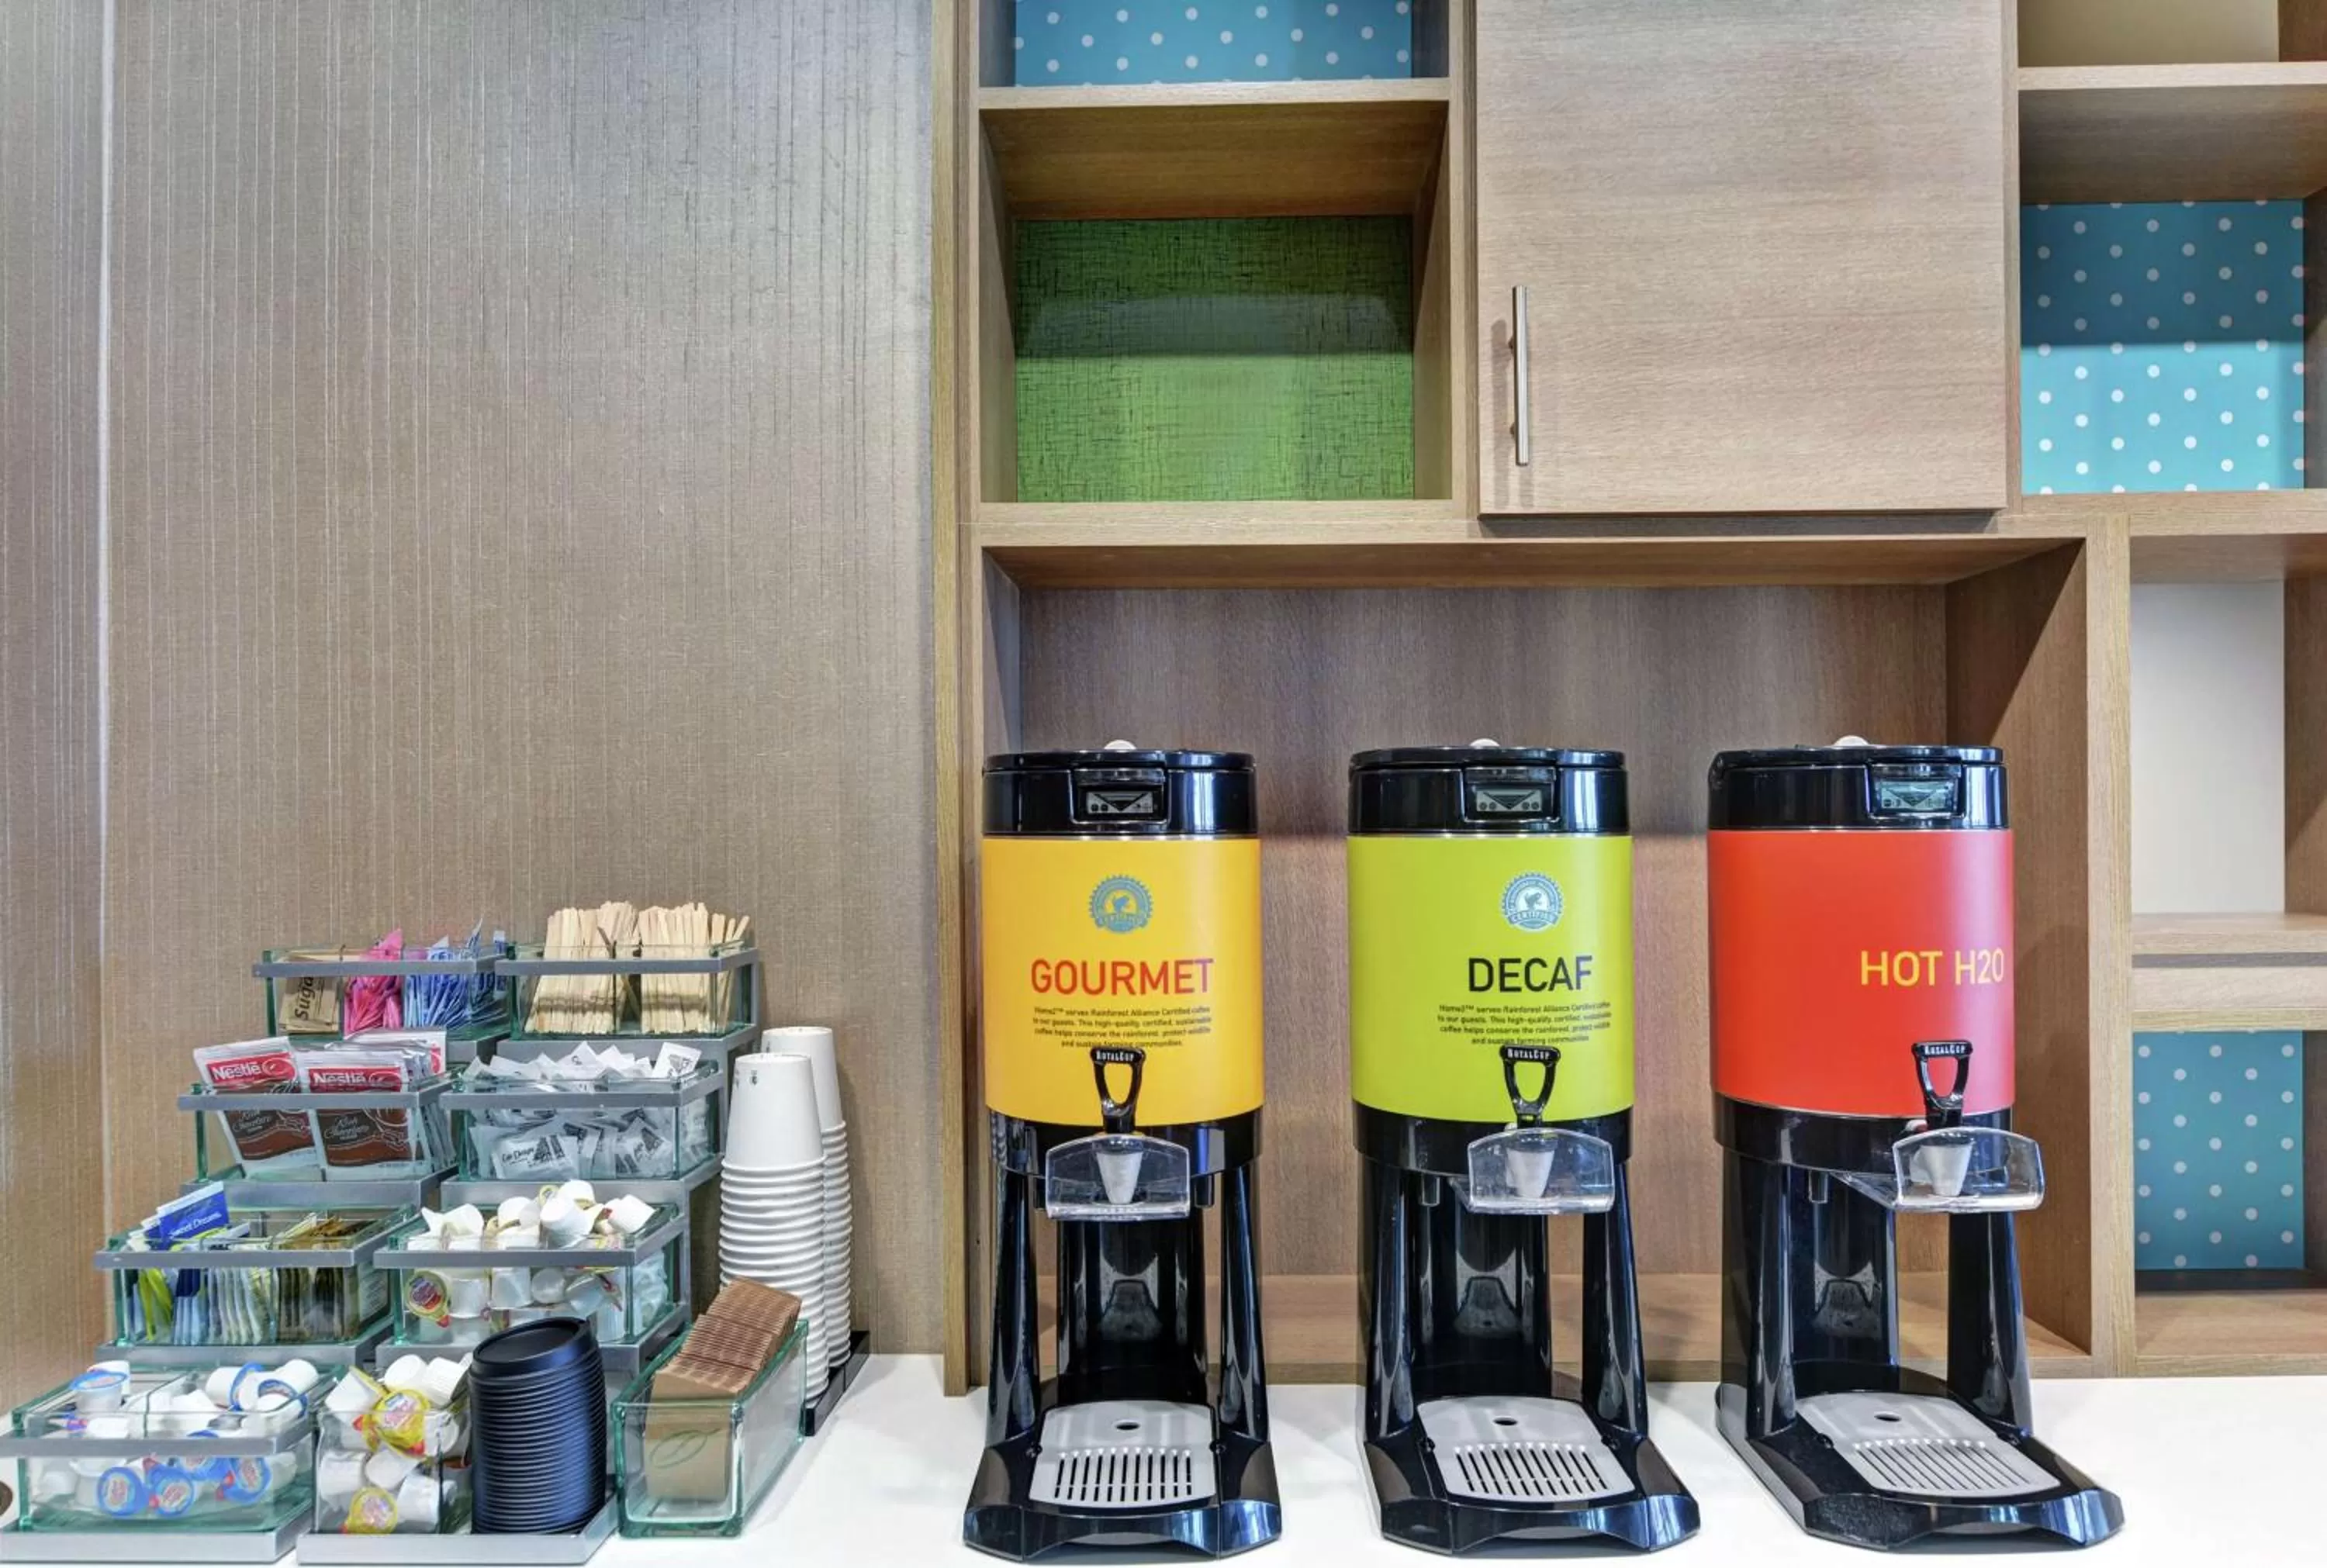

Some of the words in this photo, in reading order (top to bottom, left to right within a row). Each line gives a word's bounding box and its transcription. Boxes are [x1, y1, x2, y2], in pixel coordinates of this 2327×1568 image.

[1031, 958, 1215, 996] GOURMET
[1468, 955, 1594, 993] DECAF
[1861, 950, 1944, 986] HOT
[294, 976, 316, 1021] Suga
